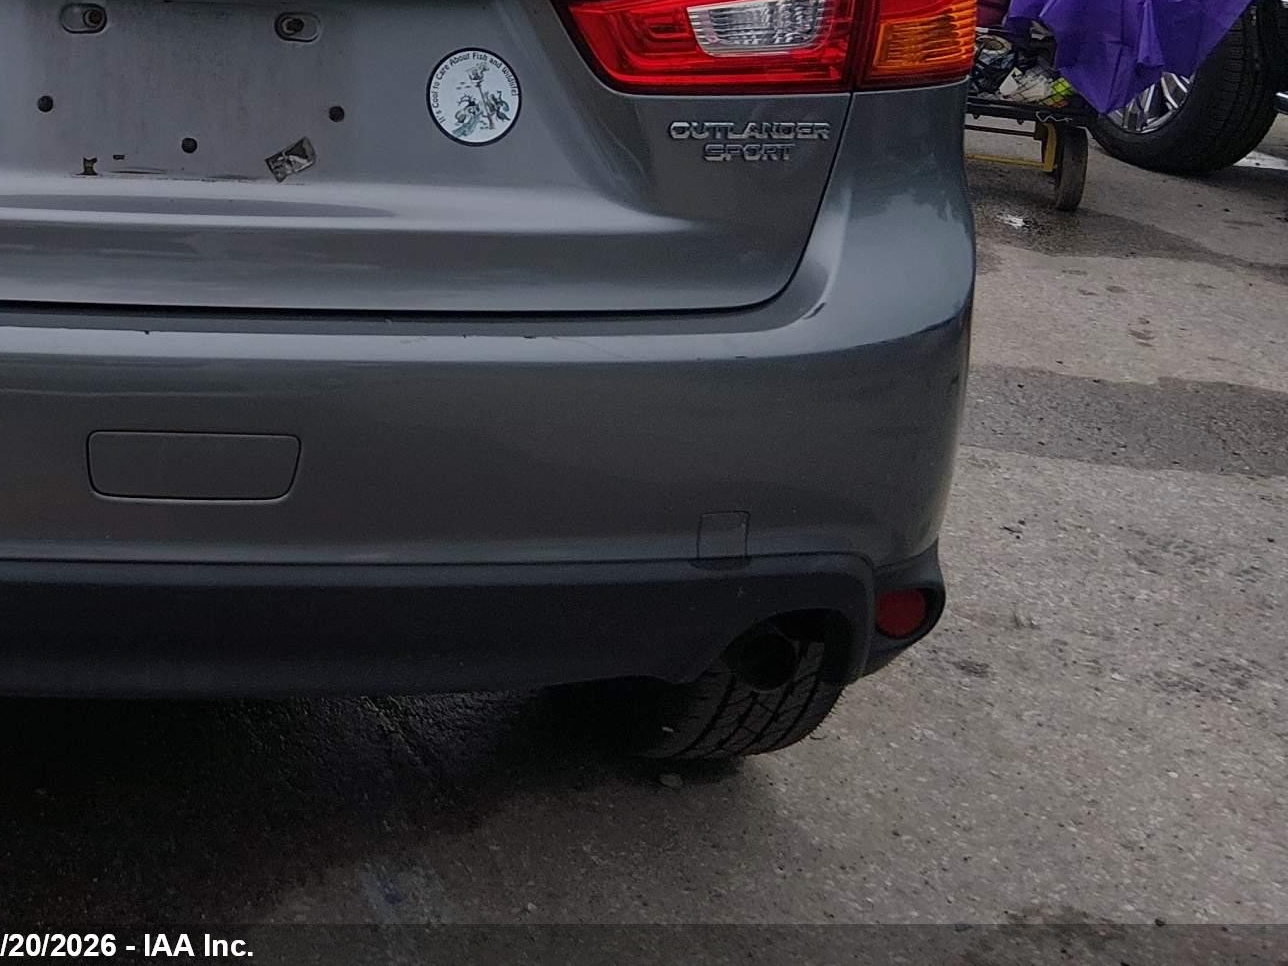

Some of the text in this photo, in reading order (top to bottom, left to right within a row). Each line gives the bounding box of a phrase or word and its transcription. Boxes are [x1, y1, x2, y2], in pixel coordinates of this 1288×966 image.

[449, 53, 470, 66] About
[472, 51, 488, 61] Fish
[489, 57, 503, 68] and
[436, 64, 450, 80] Care
[433, 81, 440, 89] to
[432, 91, 440, 109] Cool
[669, 121, 831, 139] OUTLANDER
[703, 143, 796, 161] SPORT
